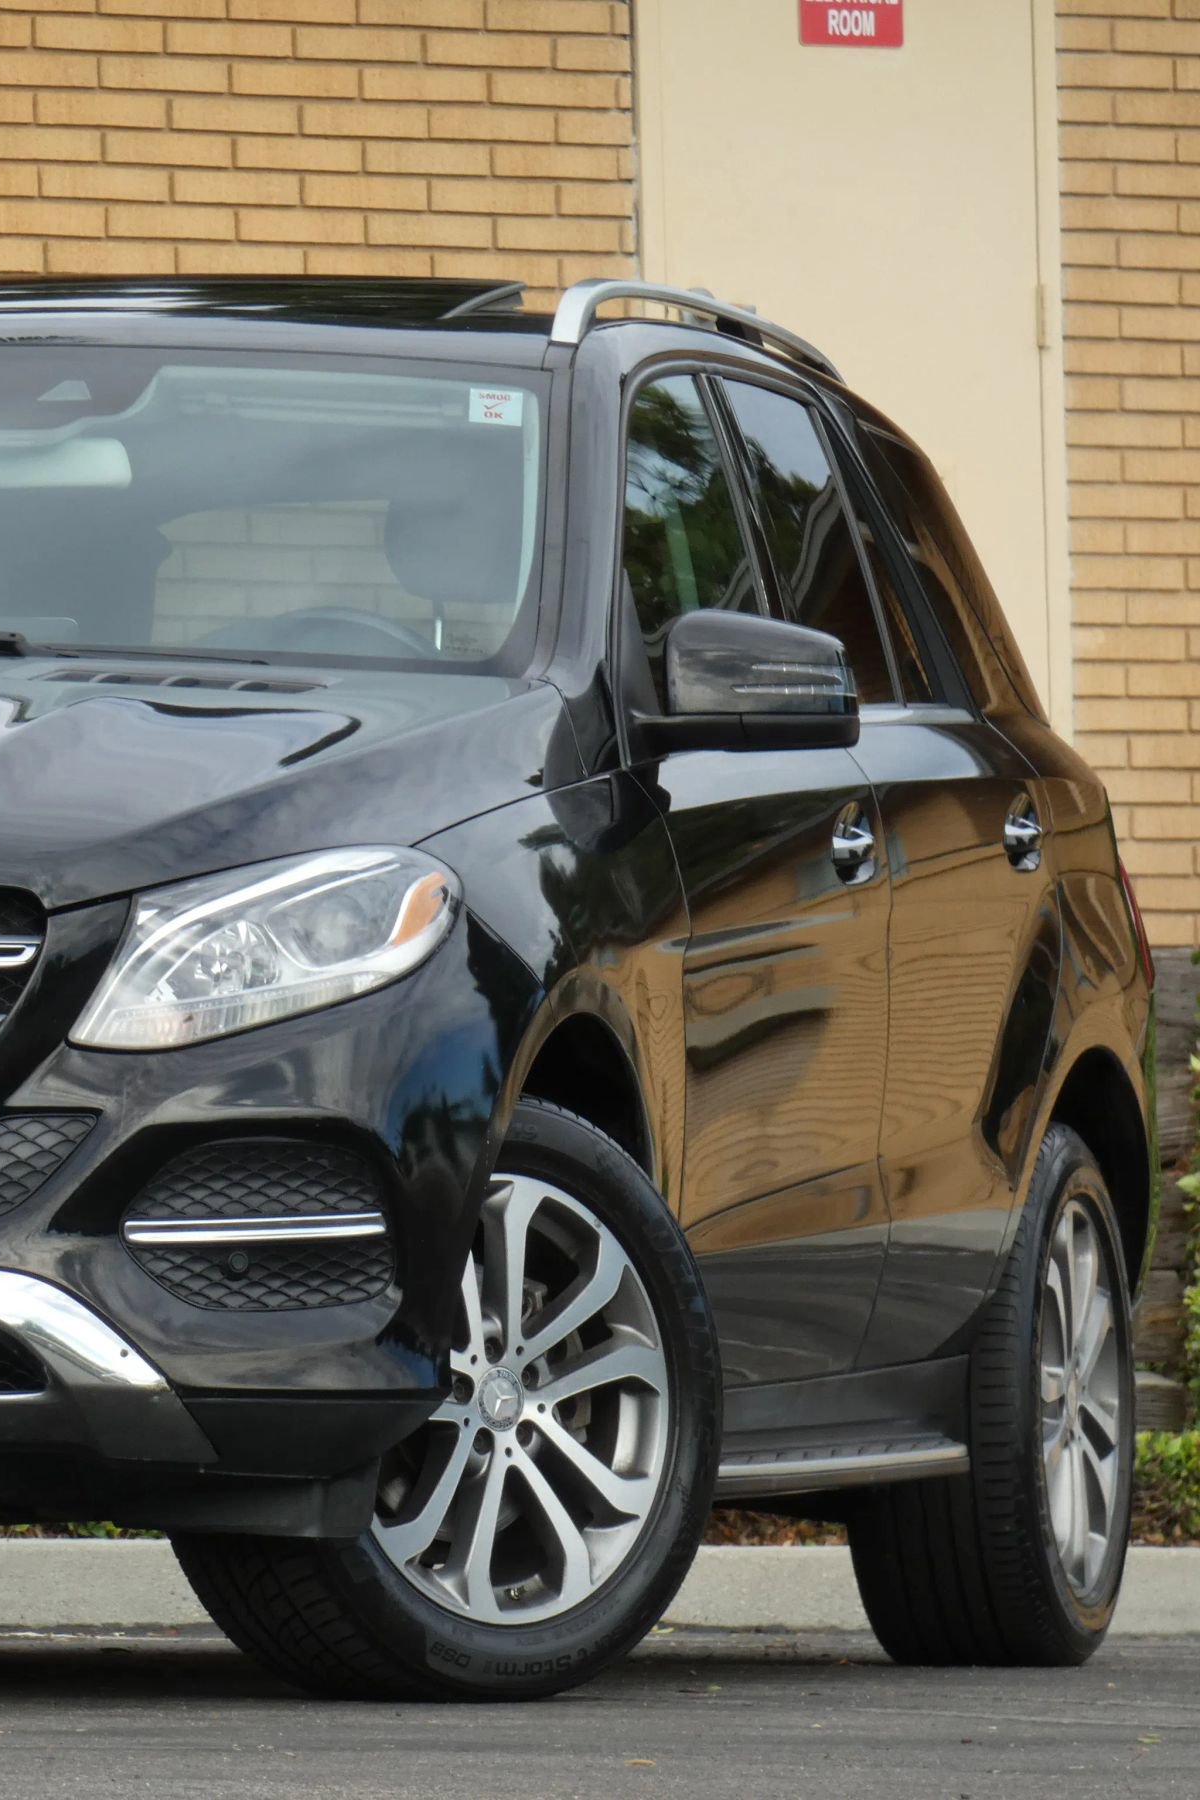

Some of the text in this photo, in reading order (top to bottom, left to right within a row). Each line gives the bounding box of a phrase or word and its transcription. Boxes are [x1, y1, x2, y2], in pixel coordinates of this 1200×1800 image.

[827, 9, 875, 37] ROOM
[484, 411, 503, 419] OK
[495, 1653, 571, 1676] Storm
